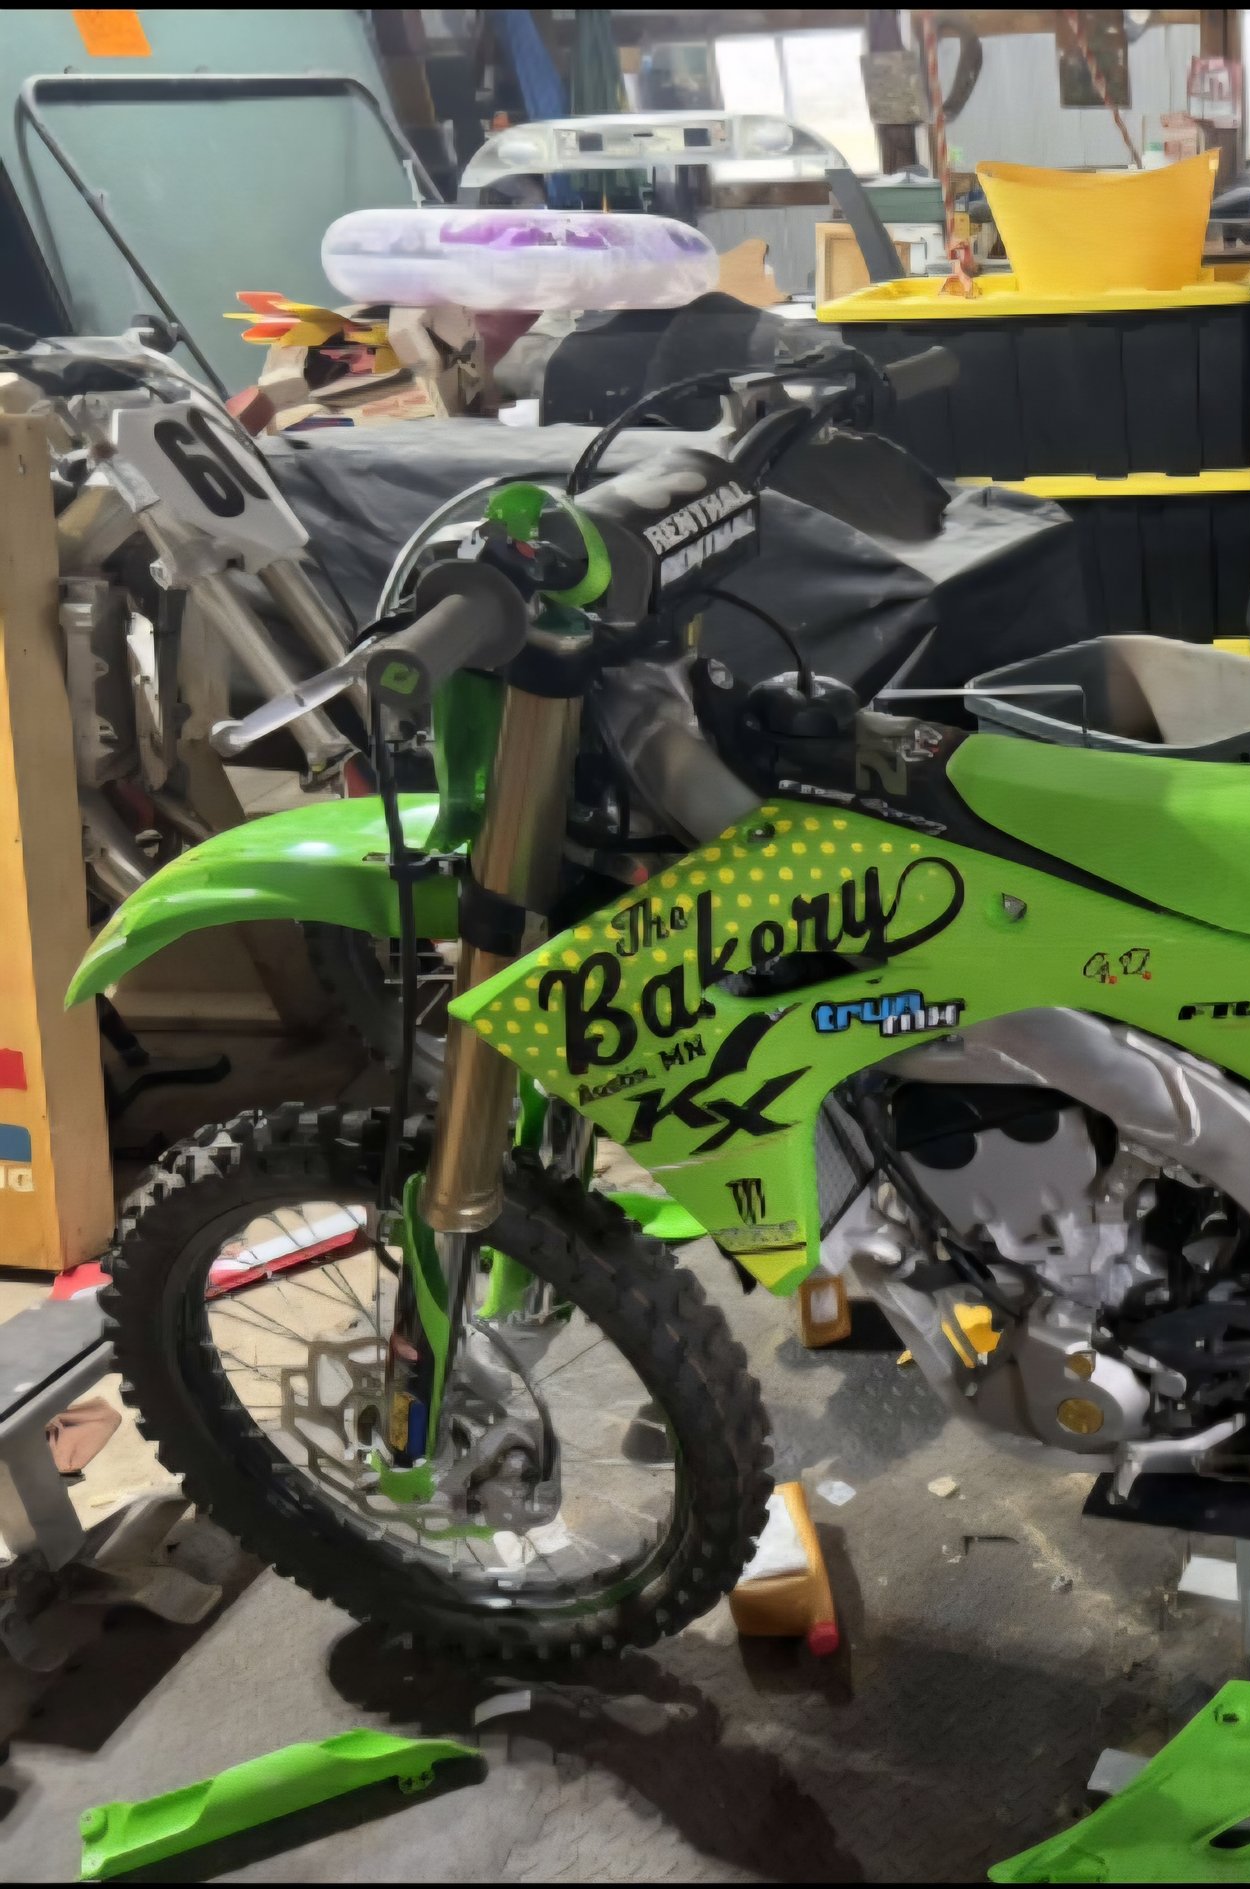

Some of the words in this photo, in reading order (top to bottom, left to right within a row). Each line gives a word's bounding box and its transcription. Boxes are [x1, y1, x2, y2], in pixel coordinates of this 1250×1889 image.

[643, 481, 757, 555] RENTHAL
[538, 856, 966, 1076] Bakery
[610, 898, 689, 957] The
[622, 1001, 814, 1156] KX
